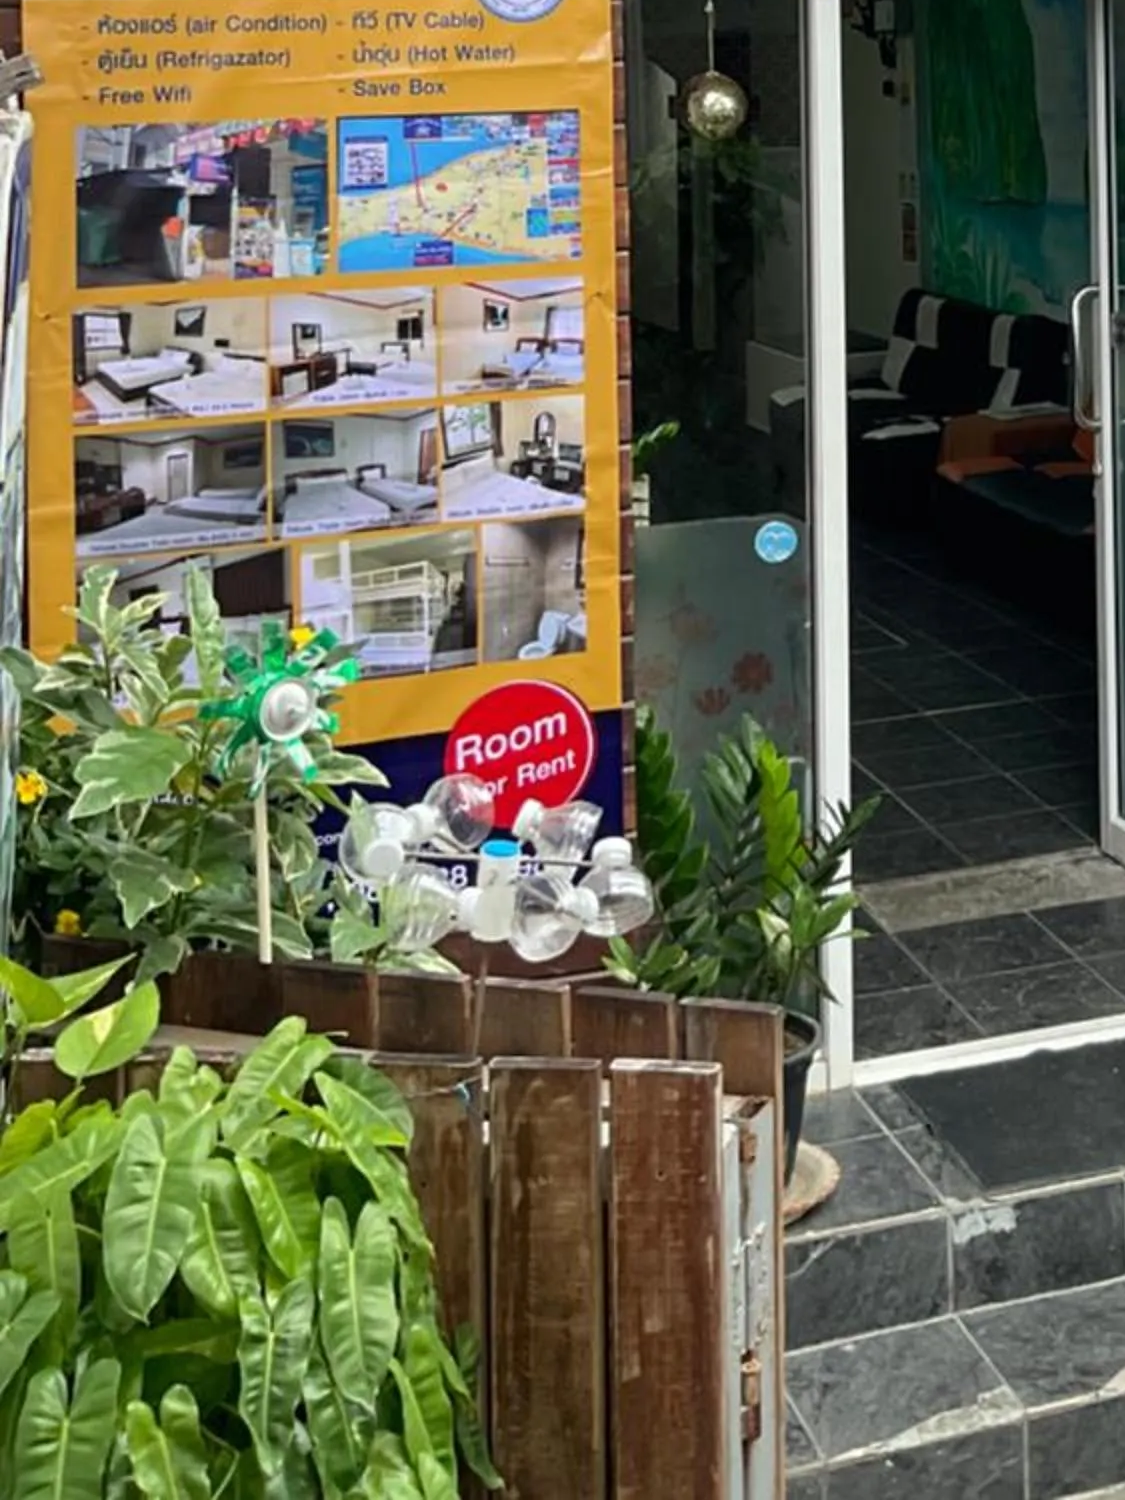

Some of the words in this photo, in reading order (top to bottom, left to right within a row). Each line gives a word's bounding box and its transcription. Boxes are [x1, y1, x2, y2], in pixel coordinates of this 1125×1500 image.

[225, 13, 327, 34] Condition)
[424, 11, 484, 30] Cable)
[454, 44, 515, 63] Water)
[98, 86, 144, 104] Free
[152, 85, 192, 103] Wifi
[353, 79, 400, 97] Save
[409, 78, 447, 95] Box
[454, 711, 568, 771] Room
[516, 748, 576, 788] Rent
